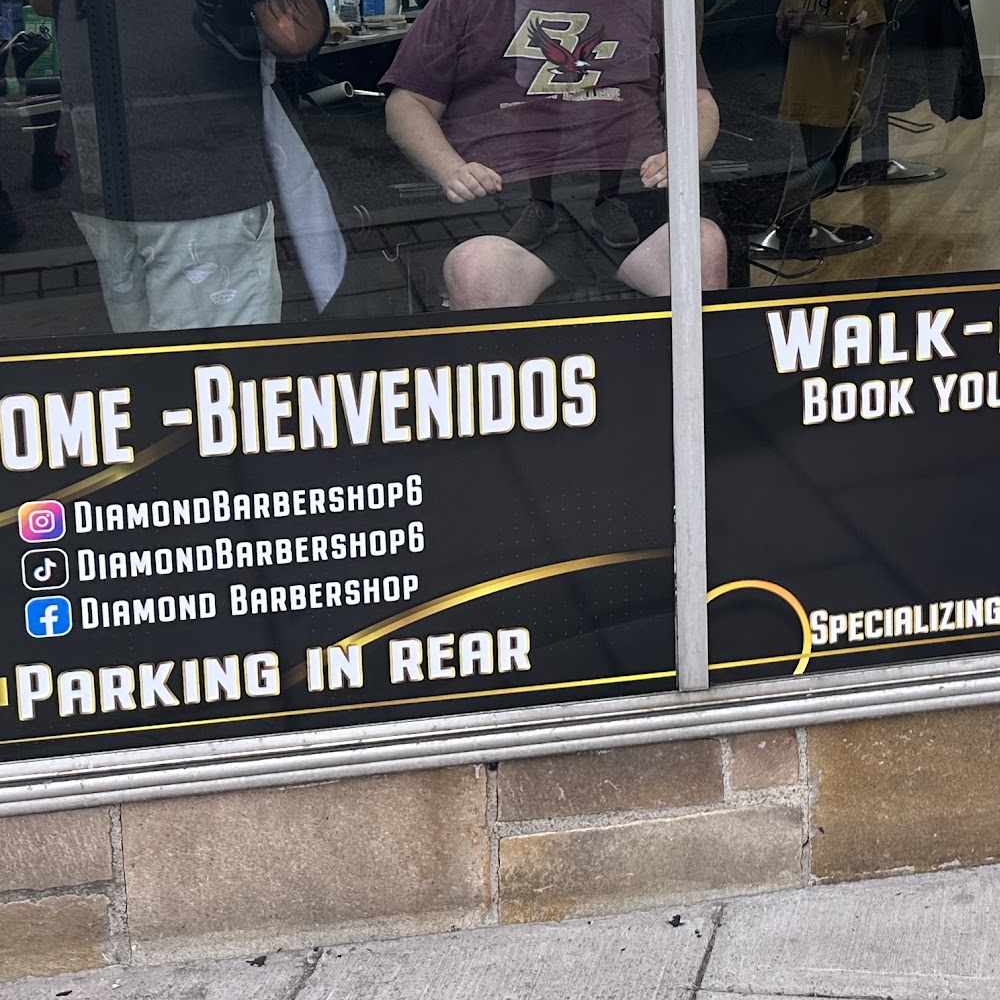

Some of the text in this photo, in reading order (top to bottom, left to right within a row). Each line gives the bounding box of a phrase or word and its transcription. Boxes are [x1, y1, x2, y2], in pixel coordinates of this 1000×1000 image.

[802, 376, 914, 425] BOOK
[80, 574, 419, 630] DIAMOND BARBERSHOP
[15, 628, 531, 722] PARKING IN REAR
